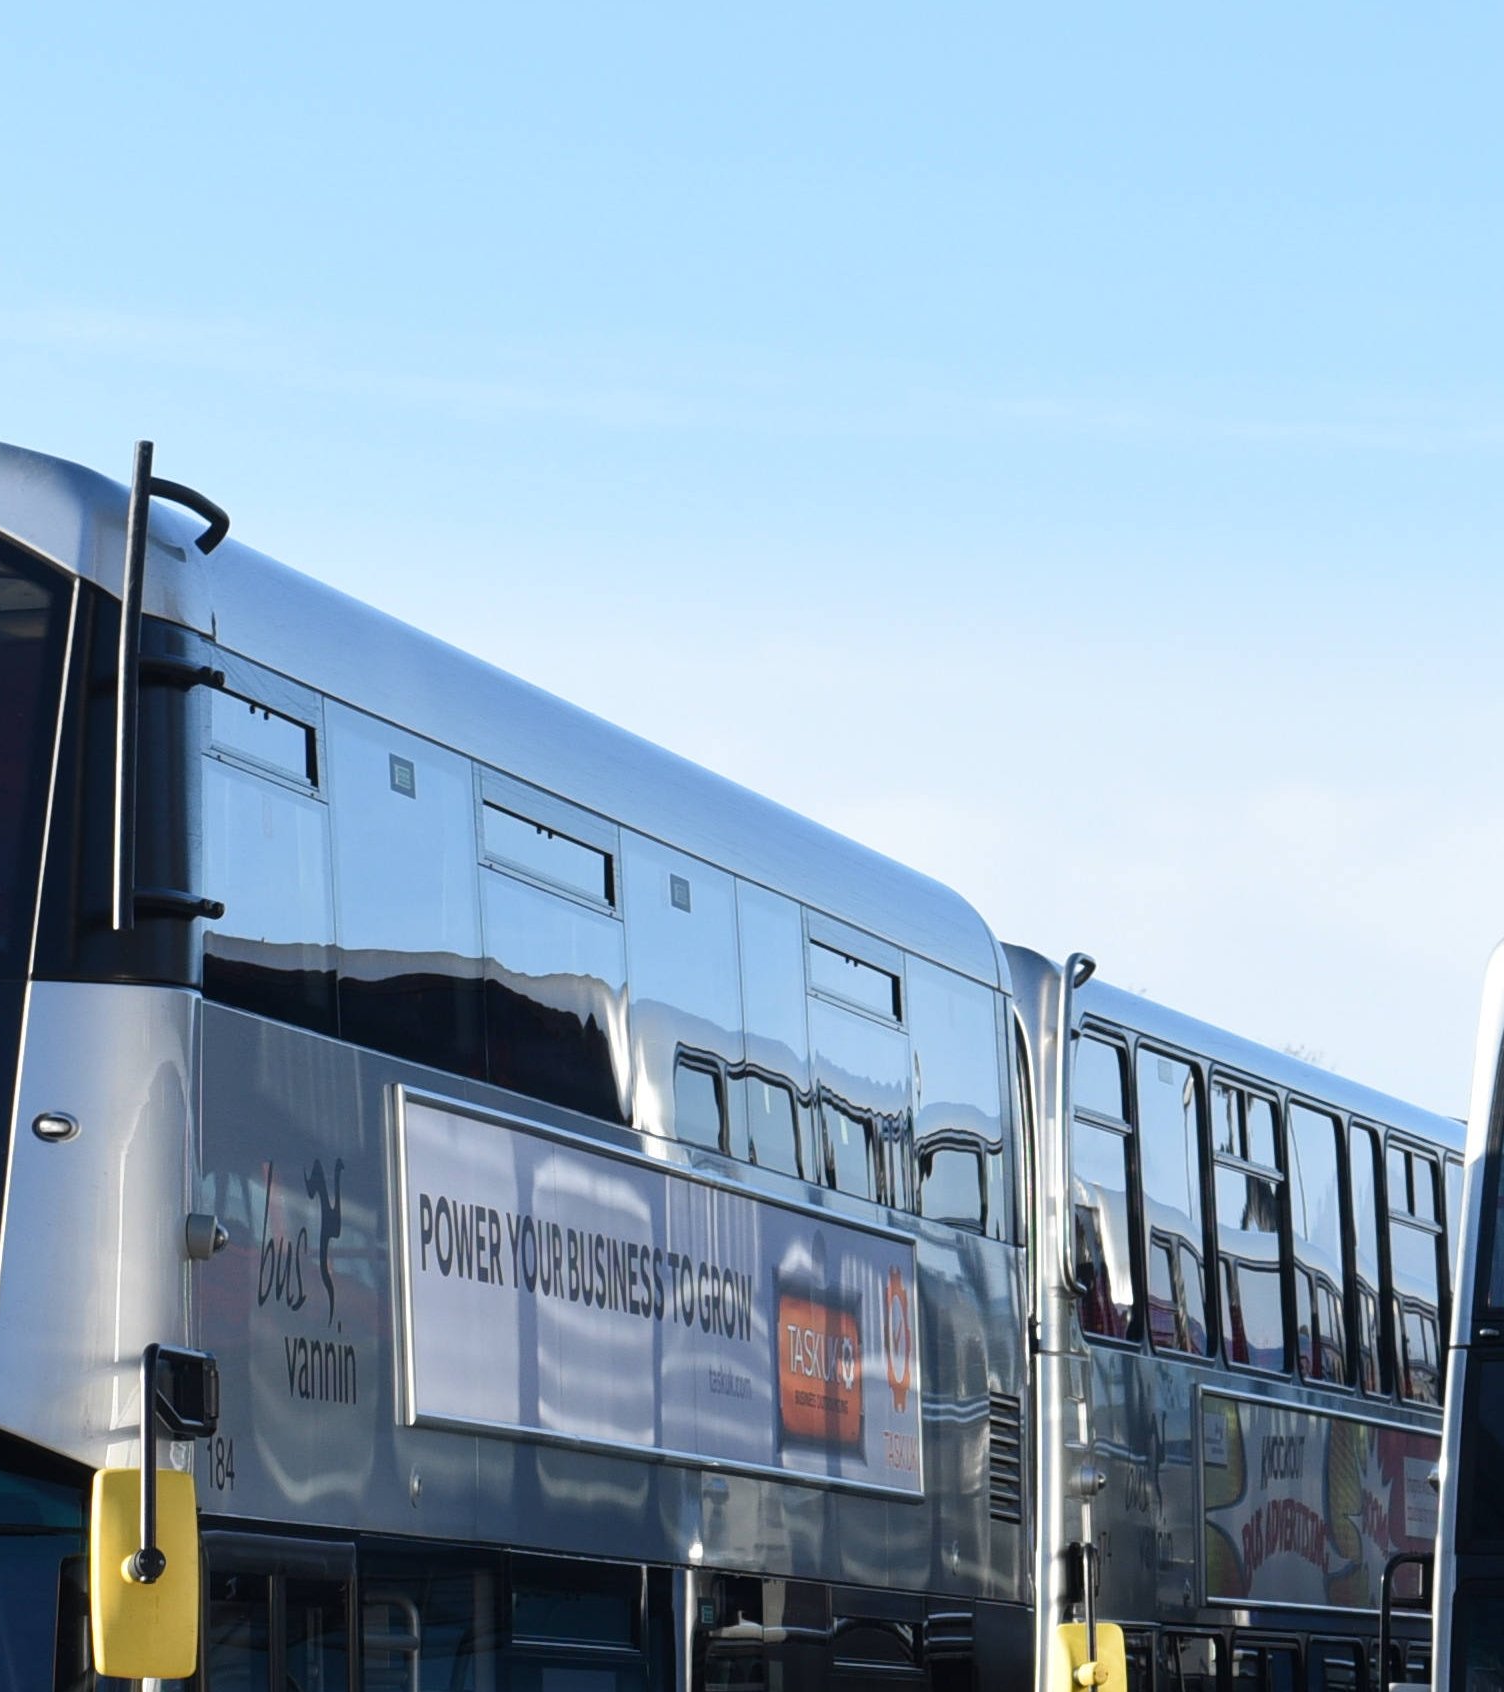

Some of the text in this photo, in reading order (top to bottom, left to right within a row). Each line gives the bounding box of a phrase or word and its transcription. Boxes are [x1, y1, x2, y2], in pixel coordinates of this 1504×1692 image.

[257, 1160, 308, 1312] bus
[420, 1193, 753, 1341] POWER YOUR BUSINESS TO GROW
[284, 1321, 357, 1405] vannin
[709, 1365, 752, 1399] taskuk.com
[787, 1324, 841, 1384] TASKUK
[207, 1435, 235, 1491] 184
